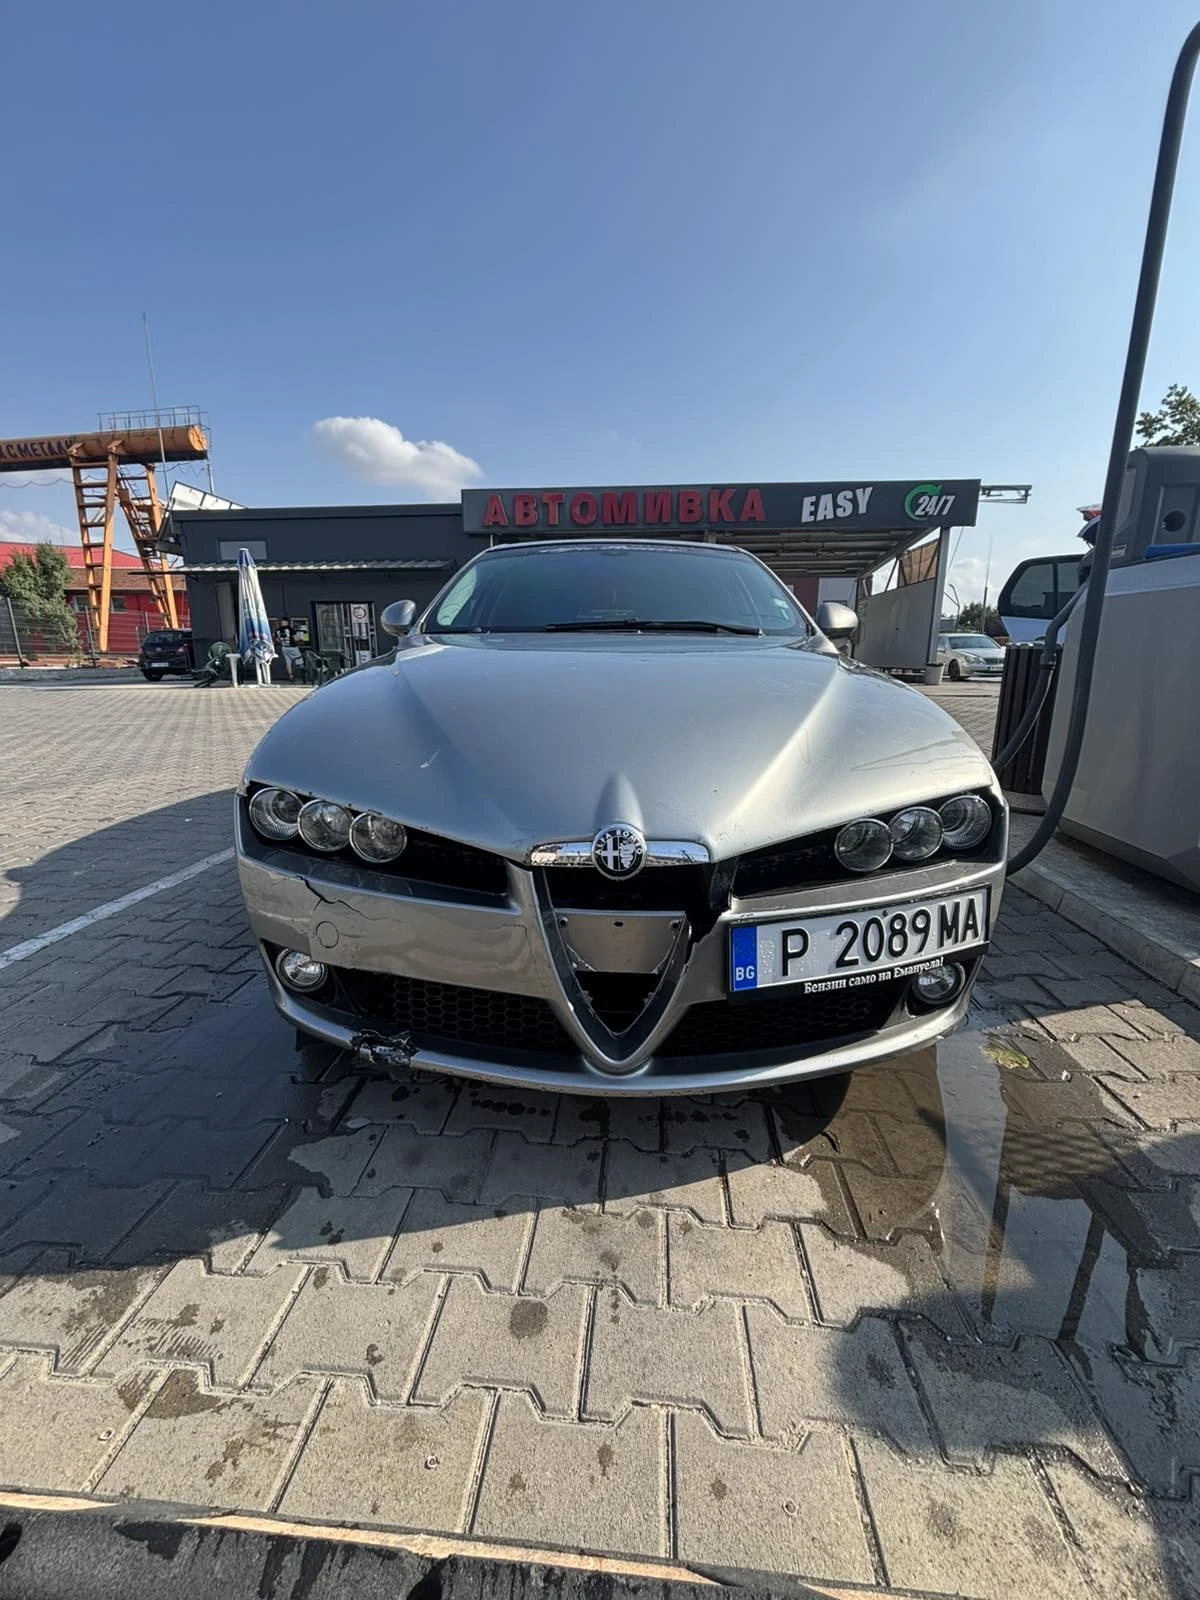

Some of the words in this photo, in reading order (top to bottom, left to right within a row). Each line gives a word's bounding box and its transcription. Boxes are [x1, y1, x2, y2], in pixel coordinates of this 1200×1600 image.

[483, 487, 766, 527] АВТОМИВКА
[801, 486, 873, 523] EASY
[914, 495, 956, 516] 24/7
[781, 927, 809, 977] P
[835, 908, 932, 969] 2089
[937, 897, 980, 949] MA
[735, 966, 755, 981] BG
[804, 978, 847, 994] Бензин
[848, 973, 876, 987] само
[878, 971, 892, 982] на
[893, 956, 944, 978] Емануела!
